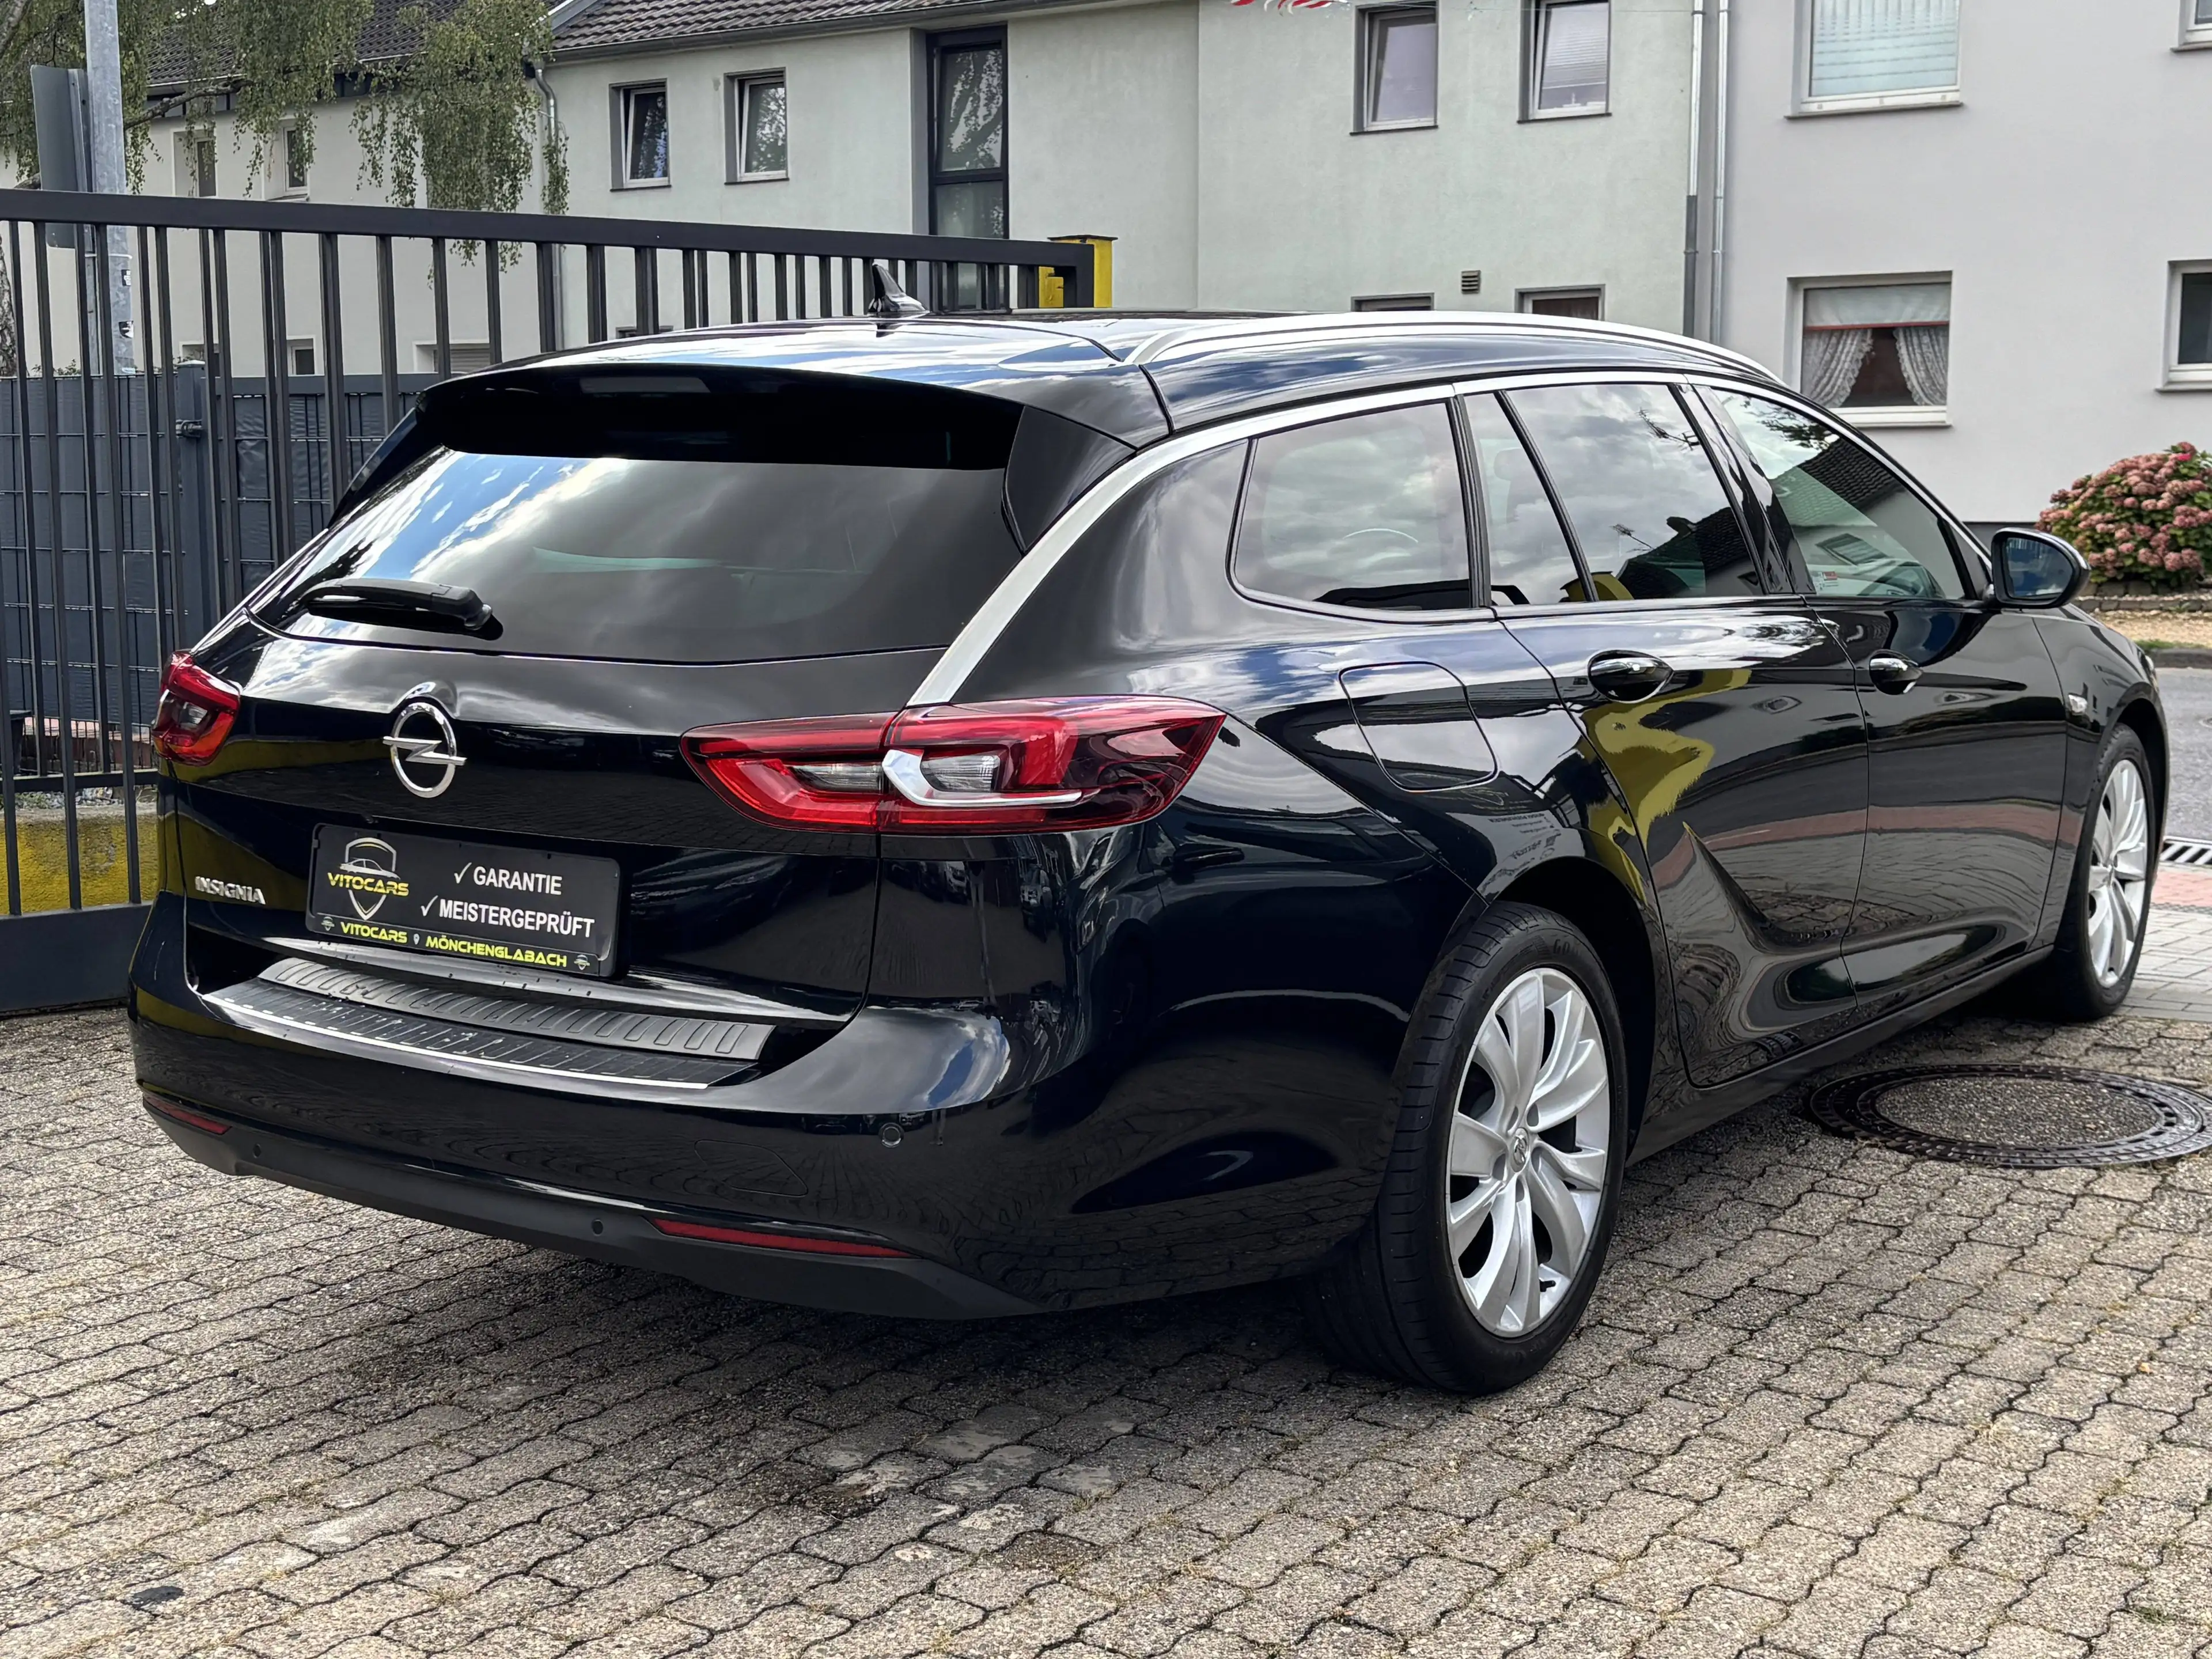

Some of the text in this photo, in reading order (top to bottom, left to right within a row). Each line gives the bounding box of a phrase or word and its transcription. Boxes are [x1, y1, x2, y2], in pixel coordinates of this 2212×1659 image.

[195, 876, 266, 905] INSIGNIA
[327, 872, 409, 896] VITOCARS
[474, 866, 562, 895] GARANTIE
[439, 899, 595, 937] MEISTERGEPRÜFT
[340, 921, 567, 967] VITOCARS MÖNCHENGLABACH
